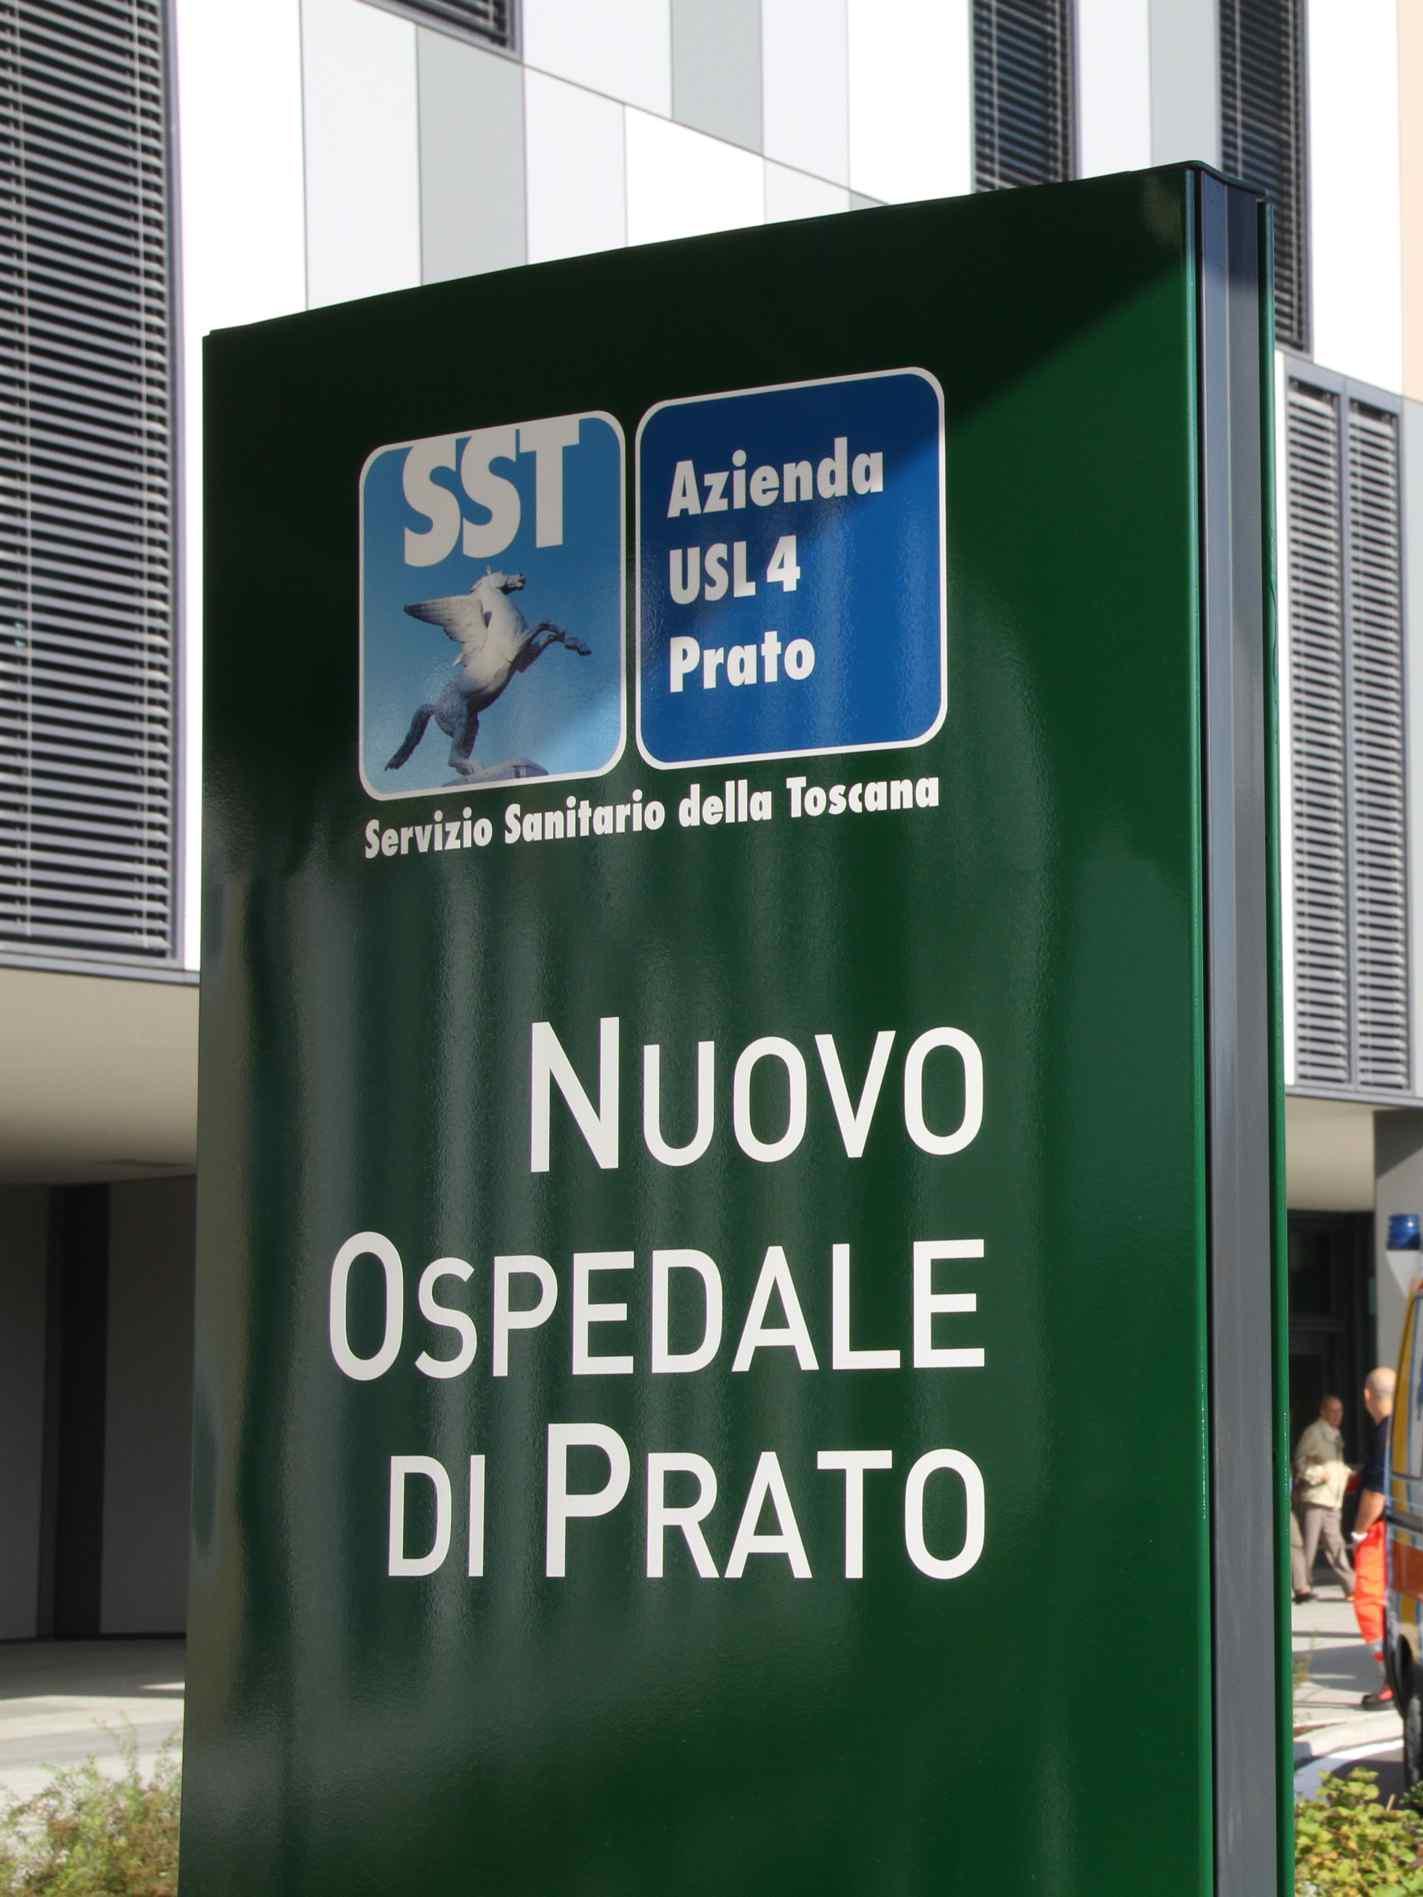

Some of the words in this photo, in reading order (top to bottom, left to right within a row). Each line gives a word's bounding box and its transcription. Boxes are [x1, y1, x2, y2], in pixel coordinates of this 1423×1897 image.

[403, 418, 580, 566] SST
[668, 437, 883, 517] Azienda
[670, 542, 755, 603] USL
[767, 535, 801, 592] 4
[670, 631, 815, 692] Prato
[366, 807, 492, 858] Servizio
[505, 789, 665, 843] Sanitario
[679, 779, 772, 827] della
[786, 776, 939, 817] Toscana
[531, 1017, 983, 1172] NUOVO
[330, 1232, 984, 1380] OSPEDALE
[389, 1455, 485, 1576] DI
[546, 1423, 985, 1579] PRATO
